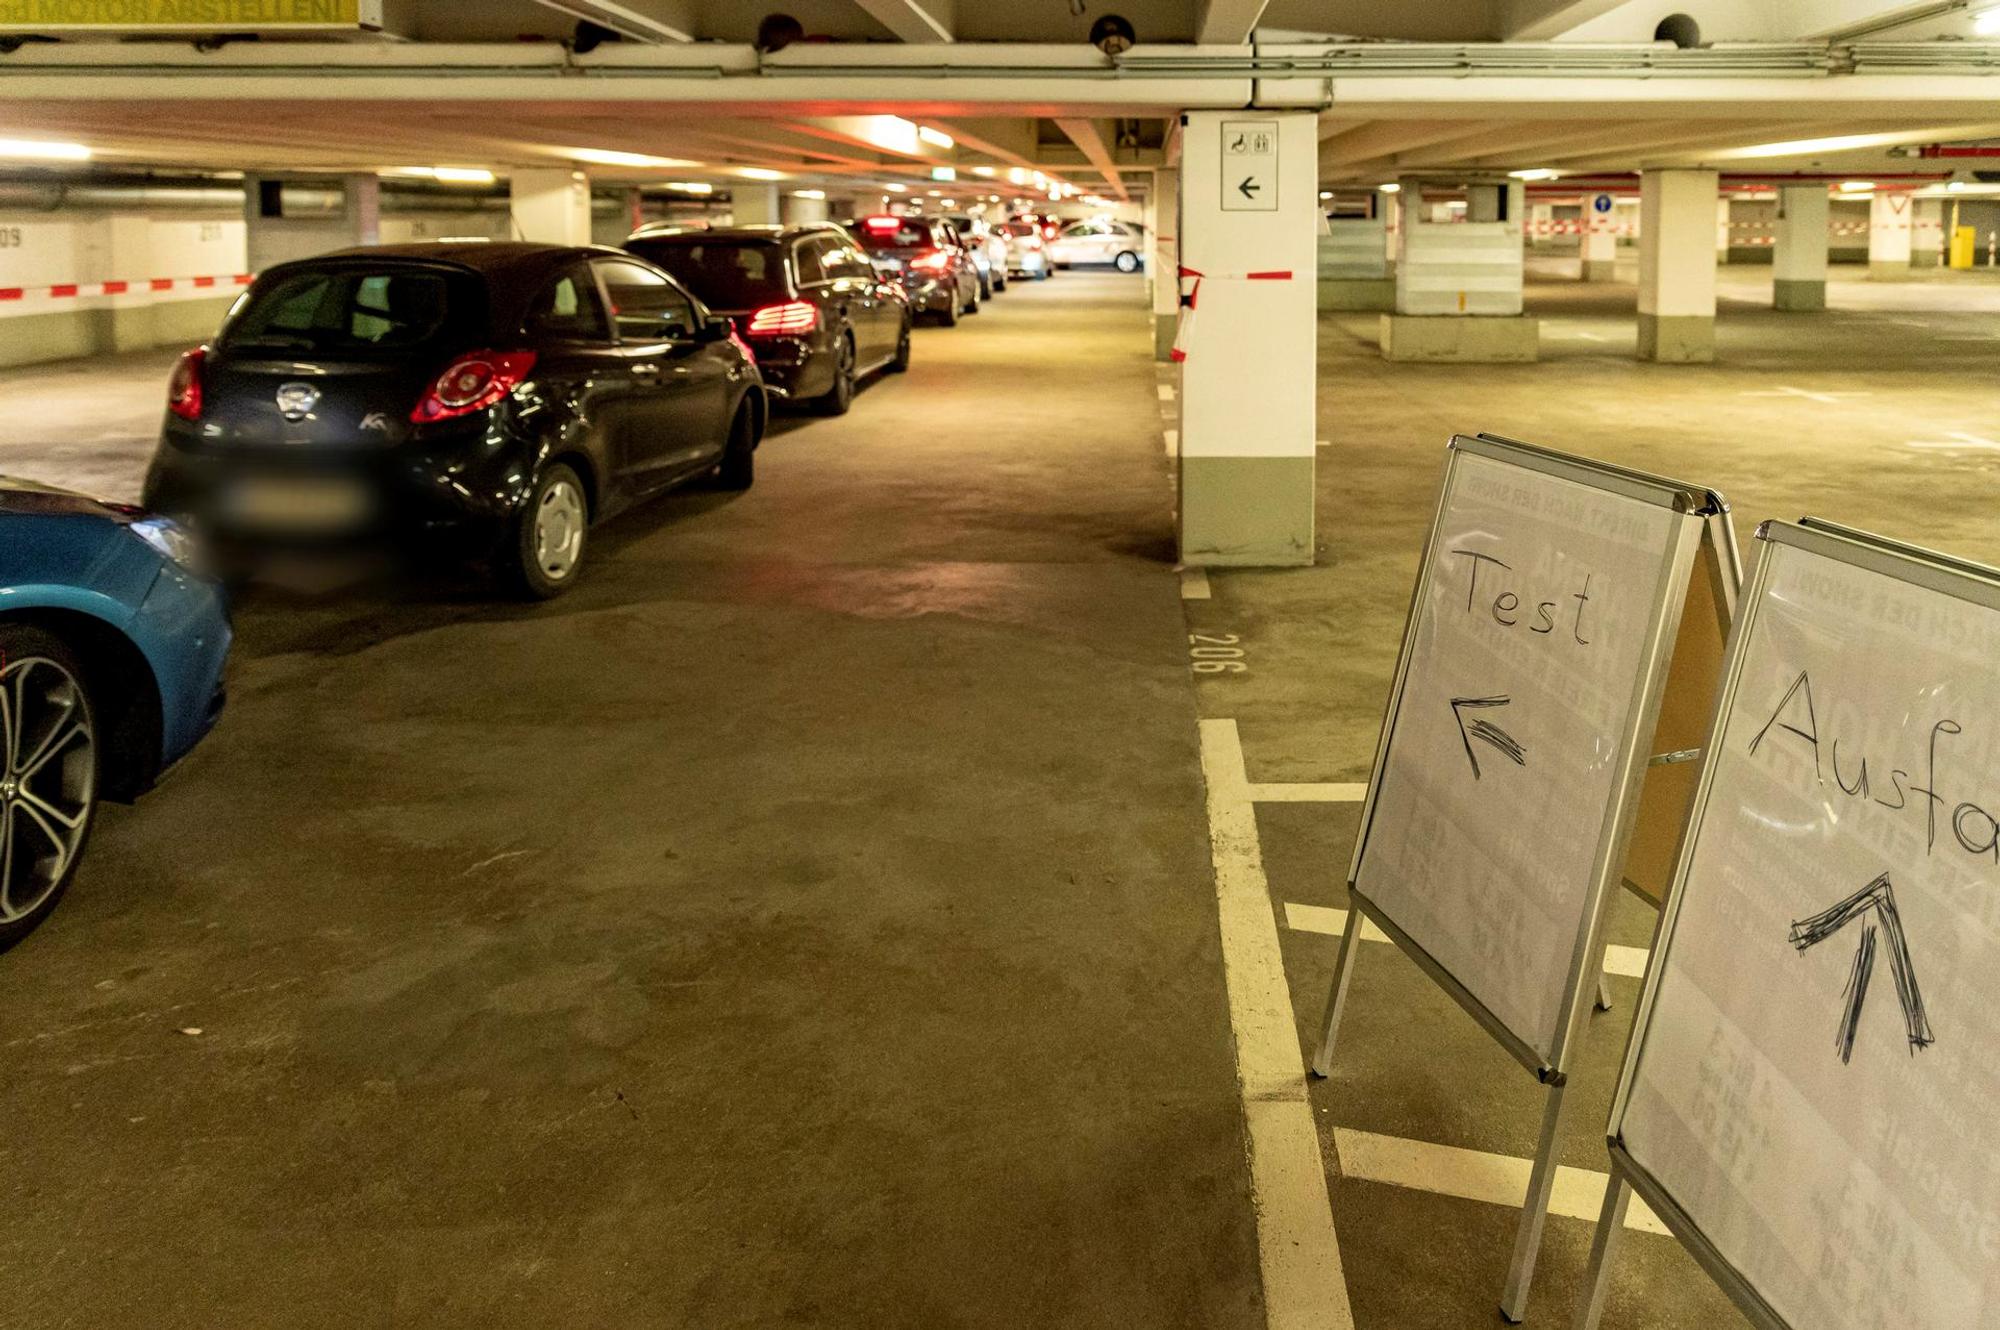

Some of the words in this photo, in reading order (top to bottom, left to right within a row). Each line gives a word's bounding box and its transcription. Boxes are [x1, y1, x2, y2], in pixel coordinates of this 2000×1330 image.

[1451, 549, 1590, 645] Test
[1188, 633, 1248, 673] 206
[1748, 669, 2000, 866] Ausfa
